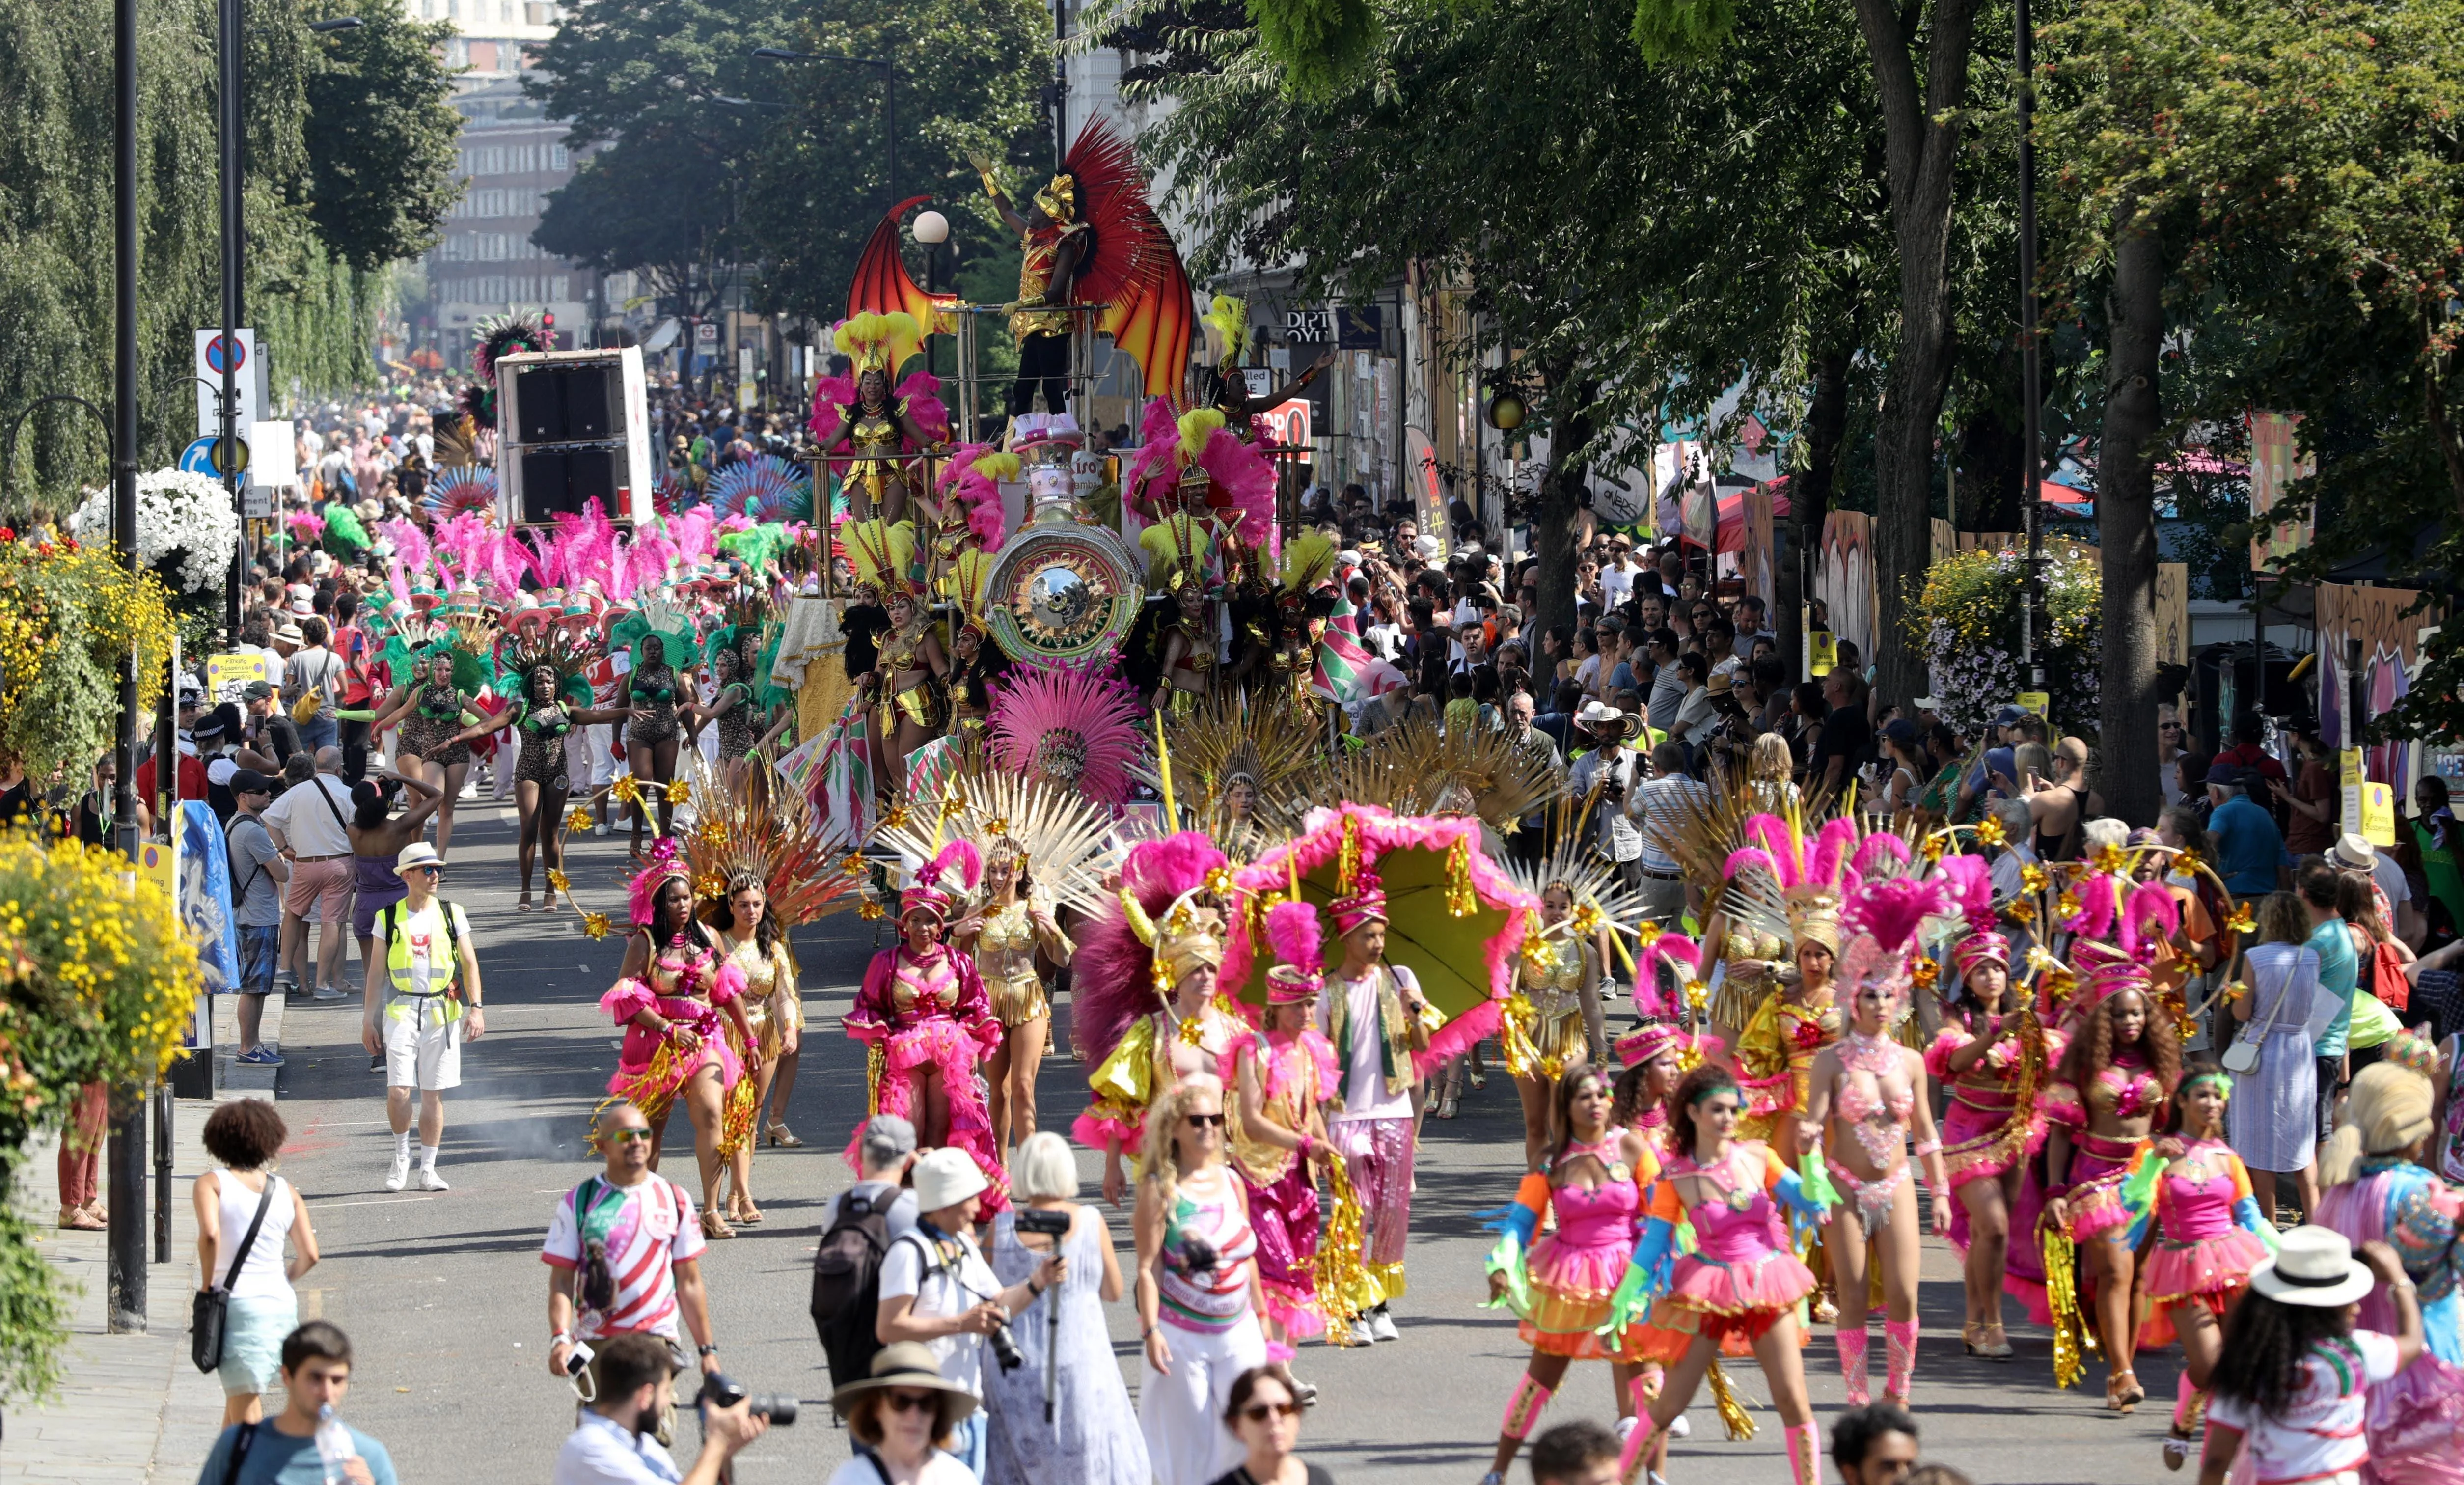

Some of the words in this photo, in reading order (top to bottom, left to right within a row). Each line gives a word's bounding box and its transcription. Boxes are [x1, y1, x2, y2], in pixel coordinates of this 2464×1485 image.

[1246, 372, 1265, 380] lled
[1262, 412, 1286, 440] OP
[2369, 813, 2389, 824] Parking
[2365, 823, 2394, 833] Suspension
